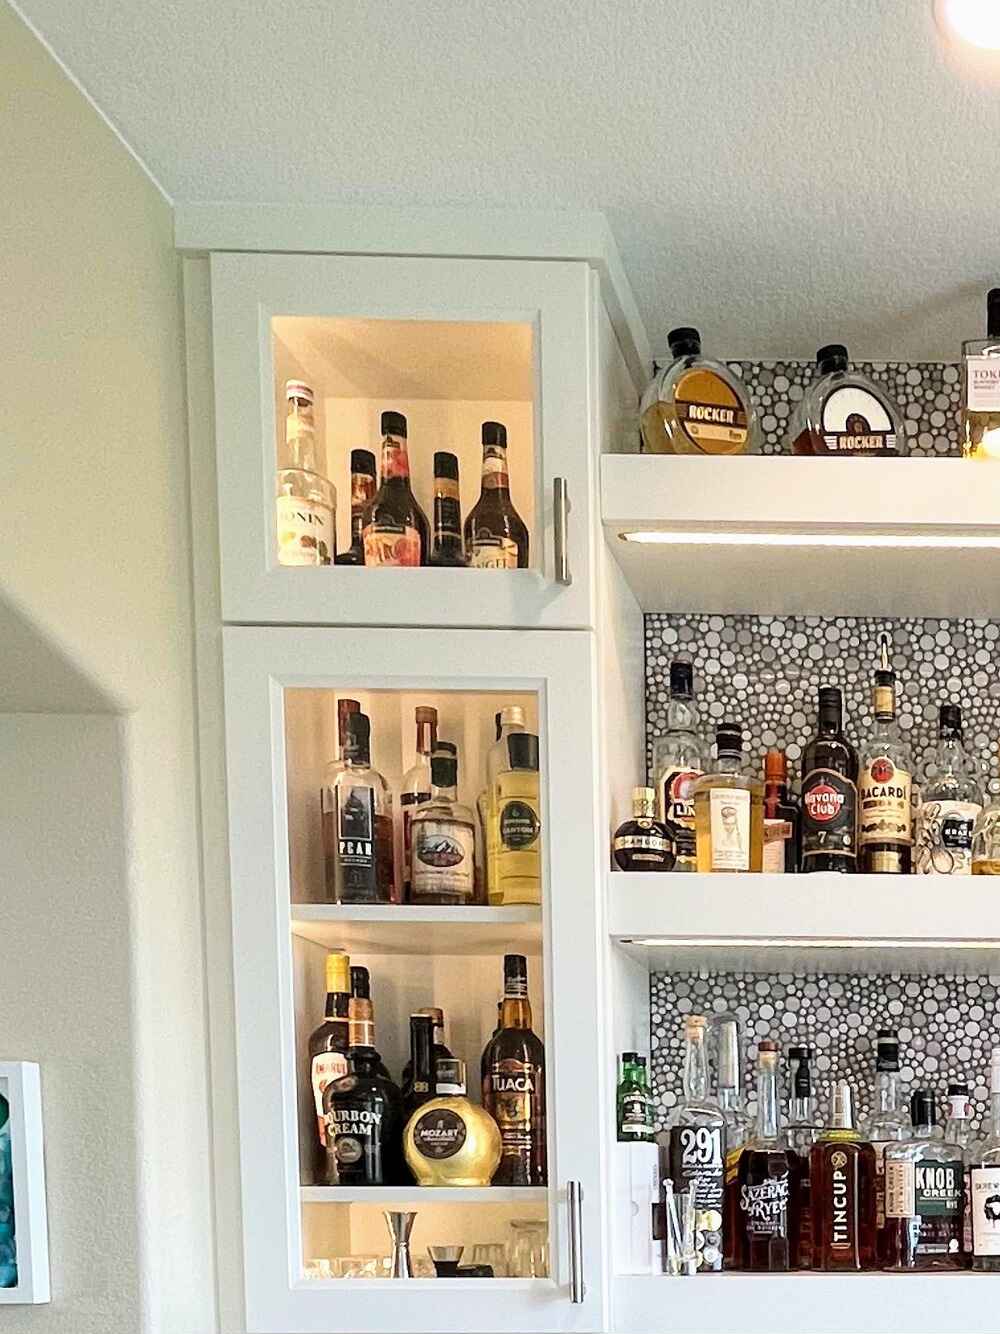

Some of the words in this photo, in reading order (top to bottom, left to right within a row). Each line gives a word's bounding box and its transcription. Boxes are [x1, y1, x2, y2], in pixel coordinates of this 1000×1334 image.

[688, 404, 734, 425] ROCKER
[839, 435, 884, 450] ROCKER
[817, 830, 828, 844] 7
[491, 1073, 535, 1092] TUACA
[327, 1122, 373, 1137] CREAM
[420, 1128, 459, 1138] MOZART
[680, 1127, 723, 1167] 291
[915, 1166, 955, 1190] KNOB
[922, 1188, 962, 1198] CREEK
[833, 1170, 848, 1242] TINCUP
